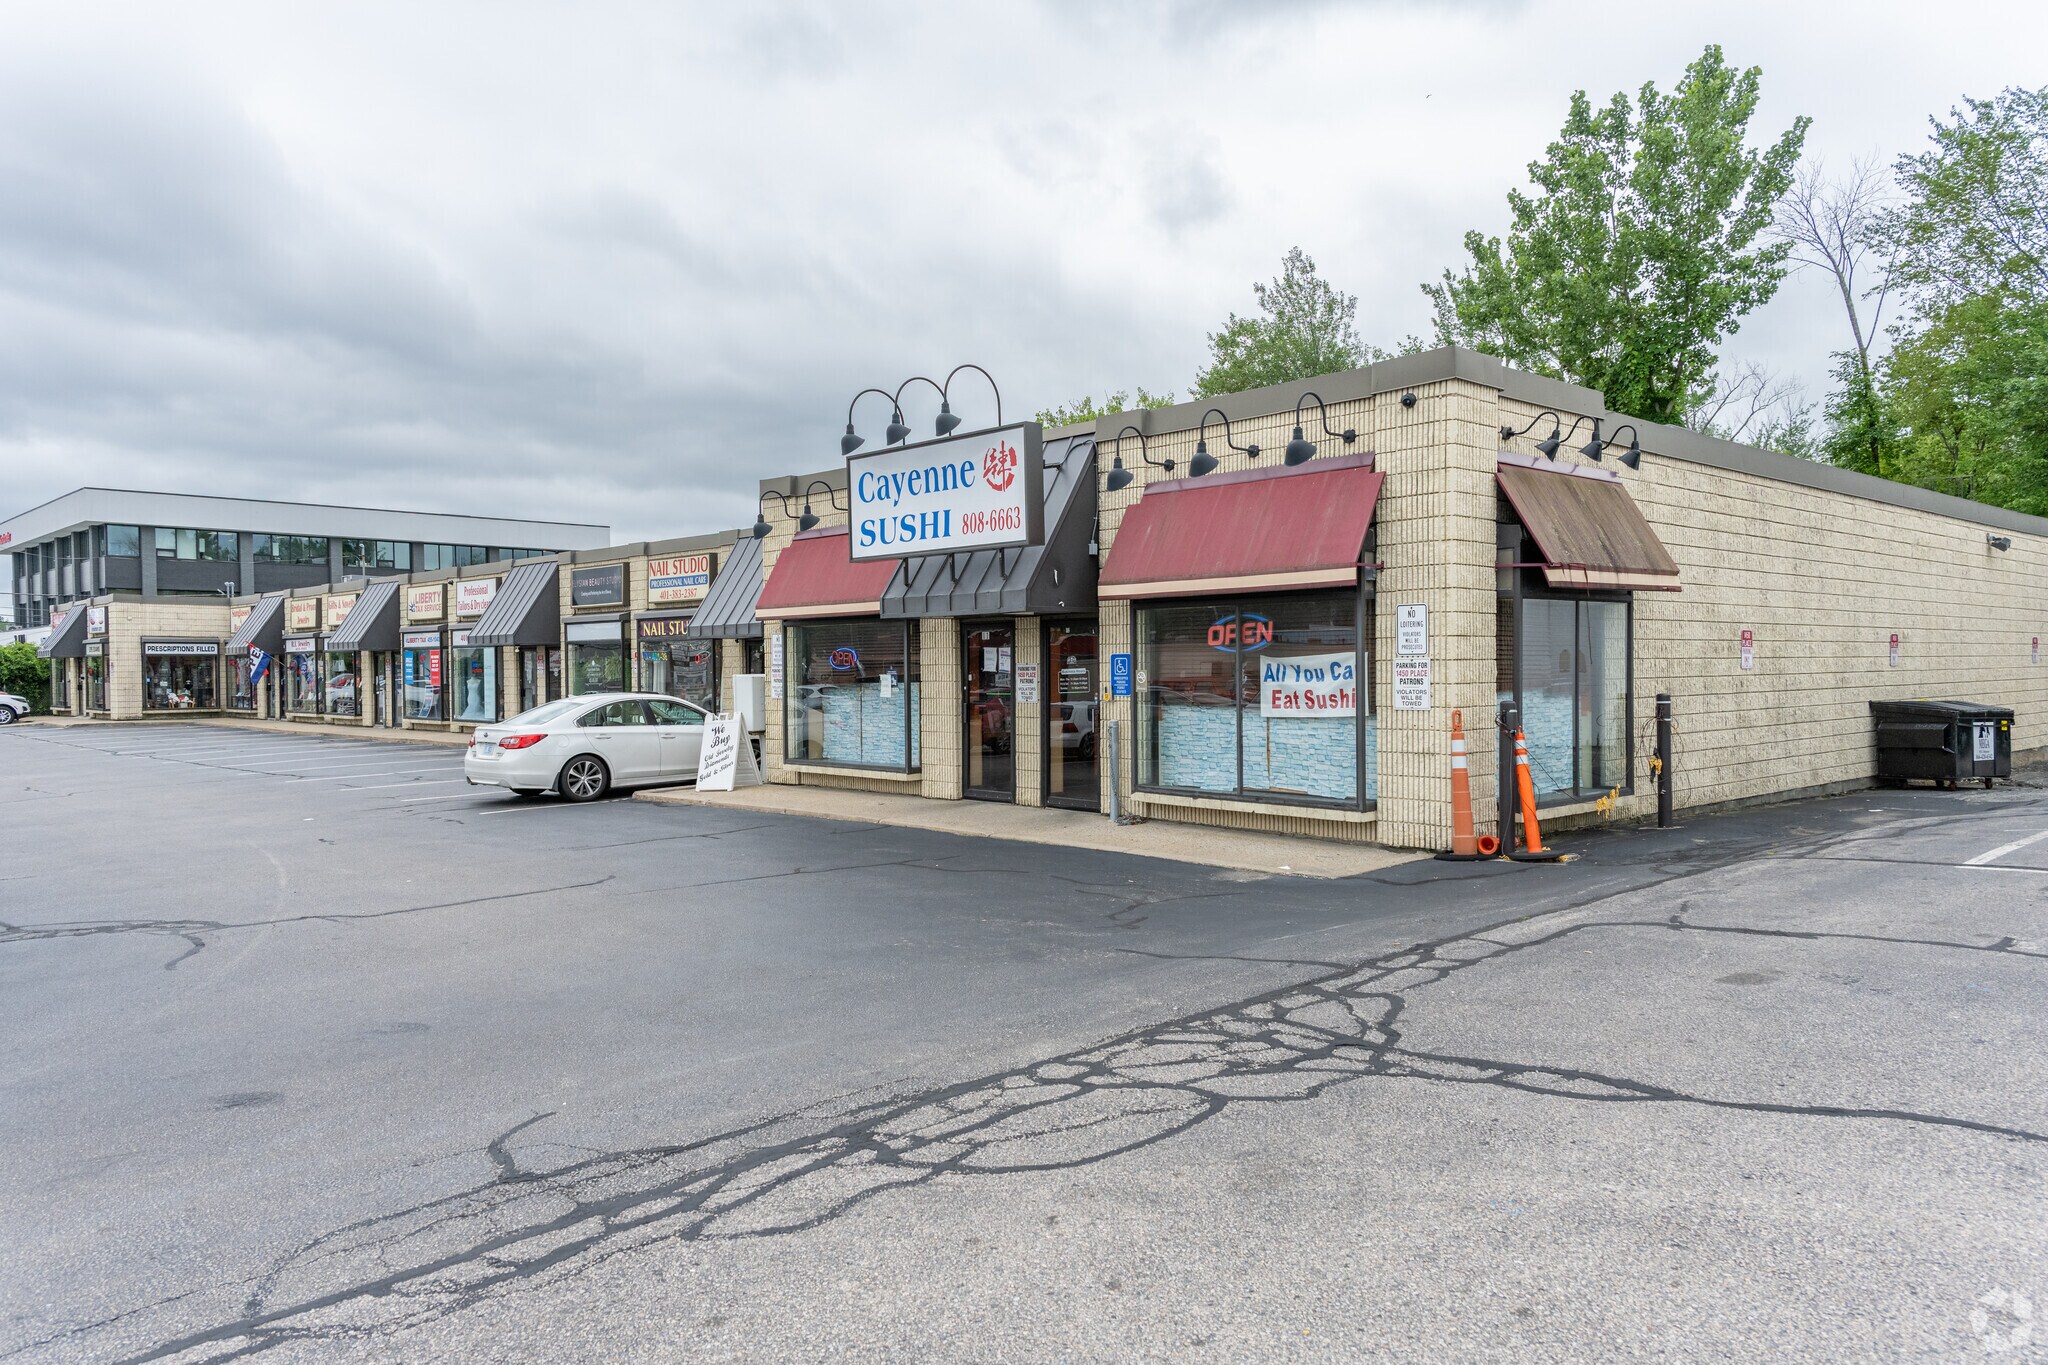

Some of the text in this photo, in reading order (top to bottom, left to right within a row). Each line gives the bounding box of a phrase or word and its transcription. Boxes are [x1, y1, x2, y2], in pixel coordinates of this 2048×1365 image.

[858, 459, 975, 507] Cayenne
[859, 506, 1020, 547] SUSHI 808-6663
[650, 556, 708, 577] NAIL STUDIO
[588, 577, 605, 586] BEAUTY
[606, 575, 622, 584] STUDIO
[651, 575, 707, 588] PROFESSIONAL NAIL CARE
[464, 584, 488, 596] Professional
[415, 591, 442, 604] LIBERTY
[415, 604, 442, 613] TAX SERVICE
[1407, 610, 1416, 618] NO
[643, 620, 688, 636] NAIL STU
[1207, 620, 1273, 646] OPEN
[196, 645, 216, 653] FILLED
[832, 651, 855, 667] OPEN
[1263, 661, 1354, 683] All You Ca
[1271, 688, 1356, 710] Eat Sushi
[712, 724, 725, 736] We
[711, 735, 730, 748] Buy
[704, 754, 729, 770] Diamonds
[705, 753, 713, 762] Old
[719, 761, 734, 772] Silver
